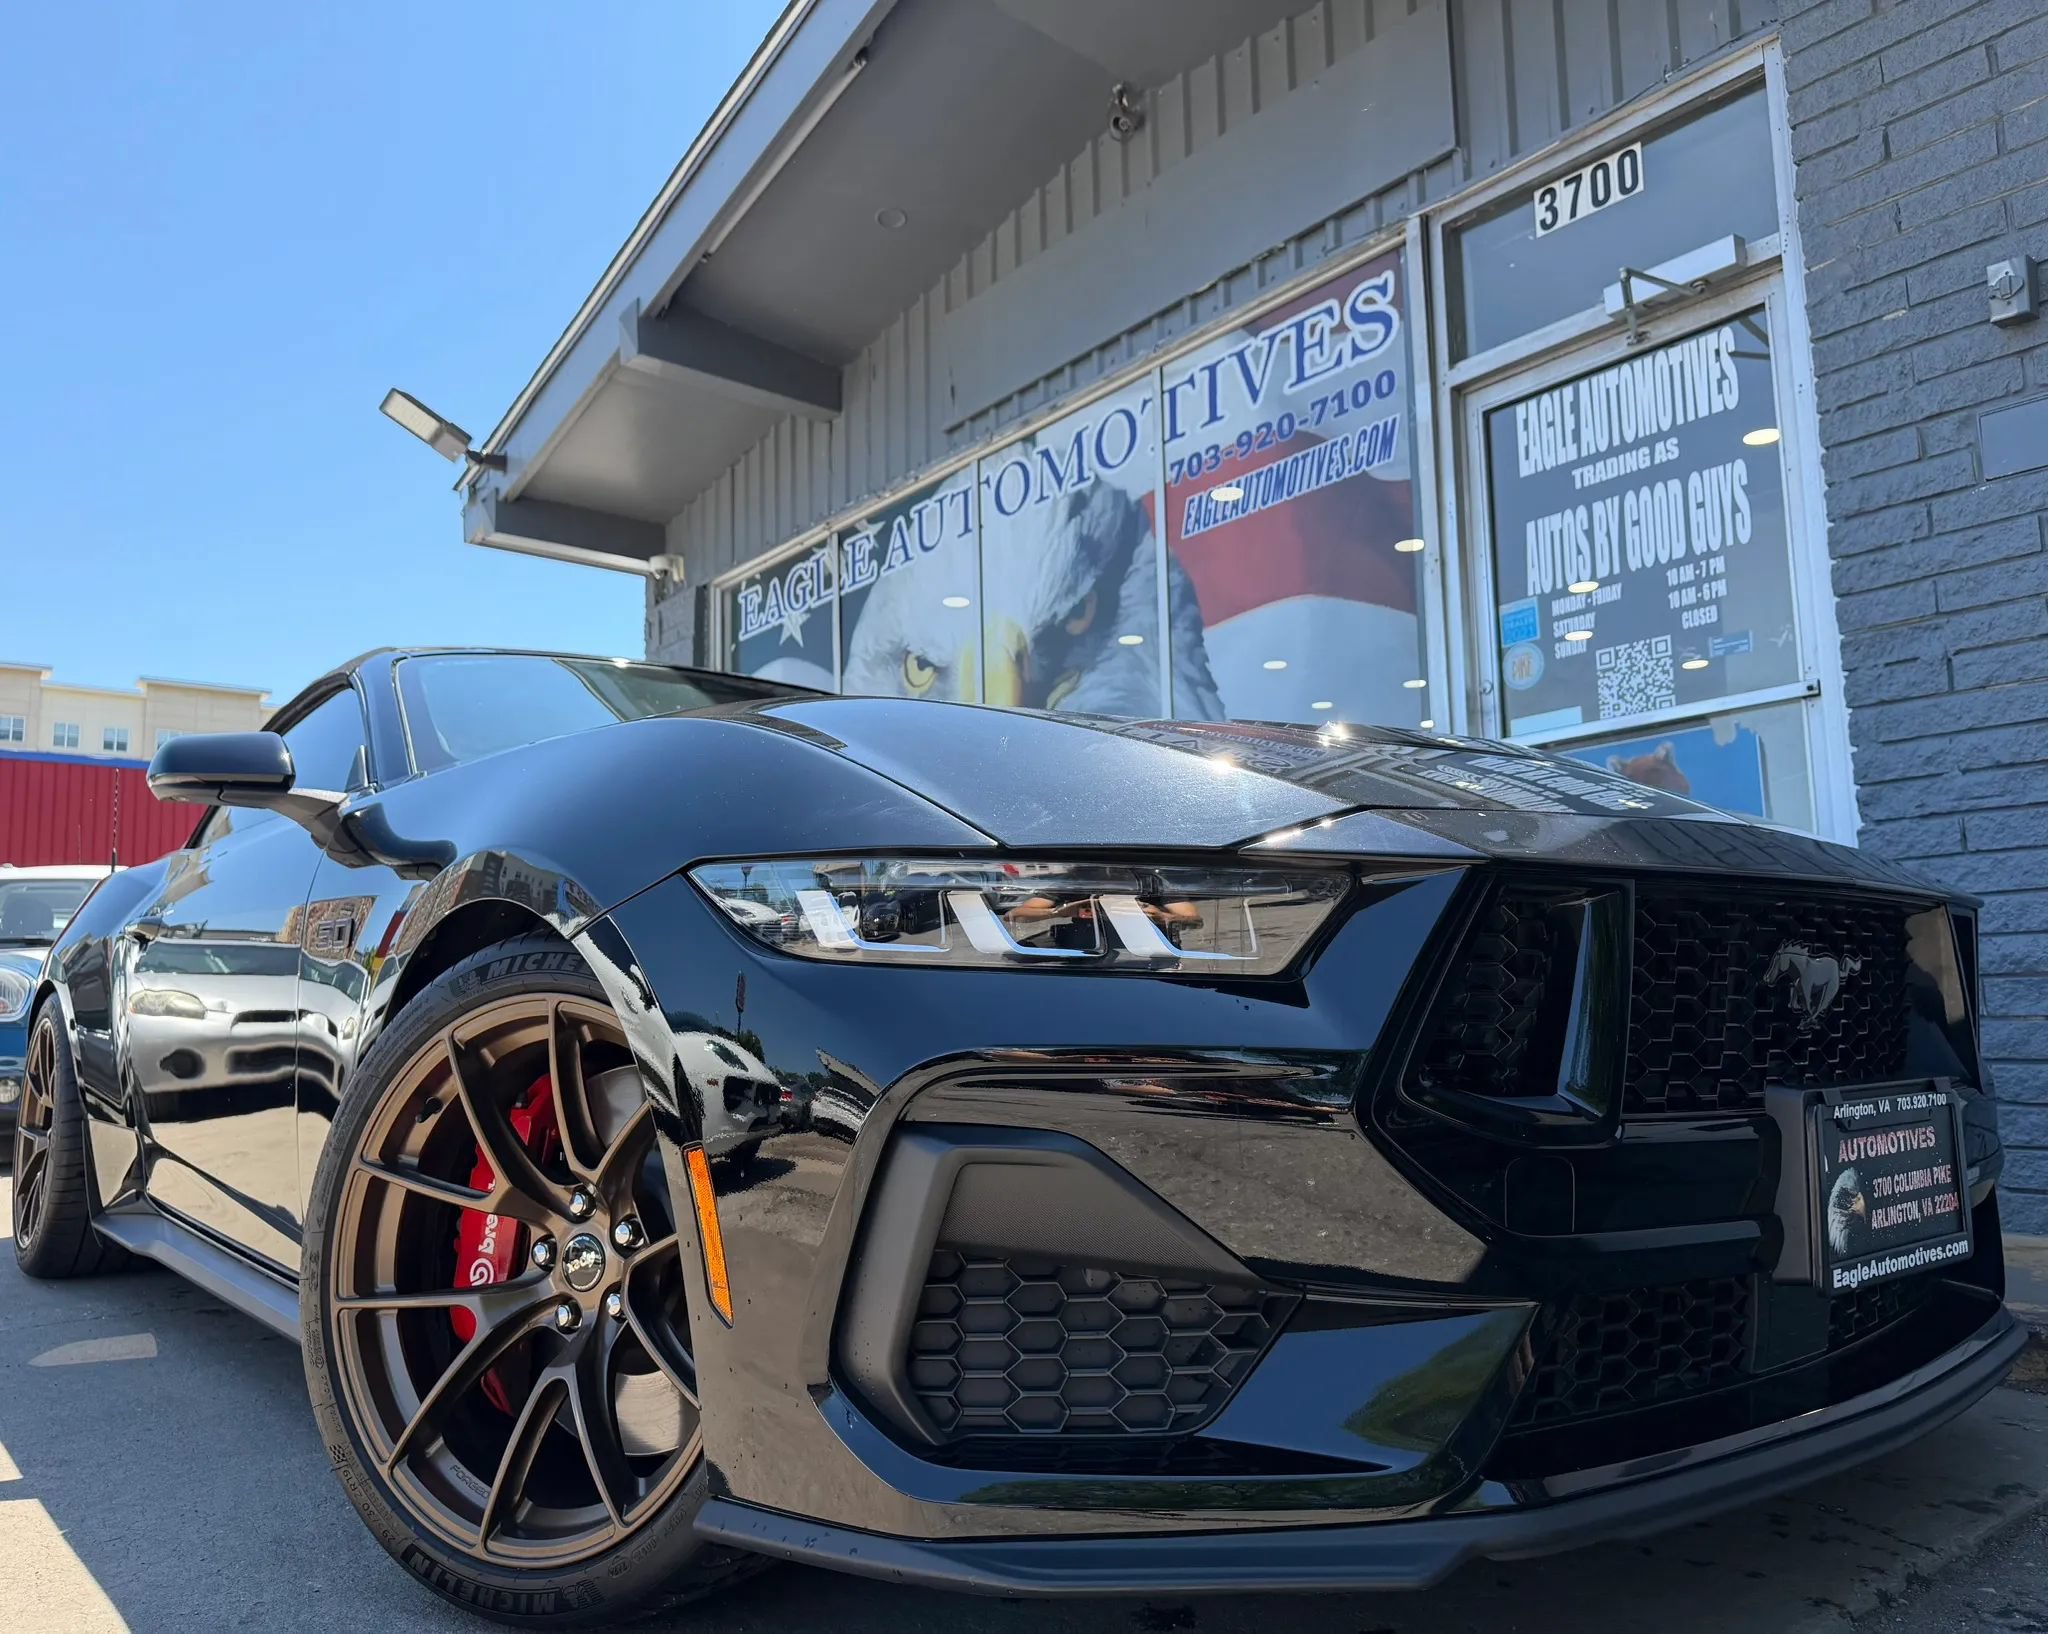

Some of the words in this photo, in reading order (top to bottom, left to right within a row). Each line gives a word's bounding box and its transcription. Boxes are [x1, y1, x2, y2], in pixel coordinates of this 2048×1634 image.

[1538, 149, 1640, 231] 3700
[1515, 387, 1578, 478] EAGLE
[1579, 326, 1740, 458] AUTOMOTIVES
[1170, 369, 1396, 487] 703-920-7100
[738, 532, 877, 641] EAGLE
[882, 270, 1399, 576] AUTOMOTIVES
[1572, 446, 1651, 489] TRADING
[1654, 437, 1680, 464] AS
[1182, 414, 1399, 538] EAGLEAUTOMOTIVES.COM
[1526, 508, 1593, 596] AUTOS
[1593, 496, 1621, 579] BY
[1623, 478, 1687, 572] GOOD
[1688, 458, 1752, 555] GUYS
[1666, 567, 1678, 587] 10
[1679, 563, 1695, 584] AM
[1700, 559, 1707, 578] 7
[1709, 555, 1725, 576] PM
[1552, 594, 1586, 617] MONDAY
[1592, 582, 1622, 606] FRIDAY
[1668, 590, 1680, 609] 10
[1681, 586, 1696, 607] AM
[1711, 578, 1727, 599] PM
[1553, 612, 1596, 638] SATURDAY
[1681, 604, 1718, 630] CLOSED
[1554, 640, 1587, 659] SUNDAY
[1833, 1102, 1876, 1120] Arlington,
[1878, 1100, 1891, 1114] VA
[1896, 1093, 1947, 1111] 703.920.7100
[1838, 1125, 1936, 1163] AUTOMOTIVES
[1872, 1177, 1892, 1198] 3700
[1893, 1169, 1932, 1195] COLUMBIA
[1933, 1164, 1952, 1186] PIKE
[1871, 1199, 1922, 1230] ARLINGTON,
[1922, 1197, 1934, 1217] VA
[1935, 1191, 1960, 1213] 22204
[1833, 1239, 1969, 1289] EagleAutomotives.com
[409, 1550, 557, 1614] MICHELIN
